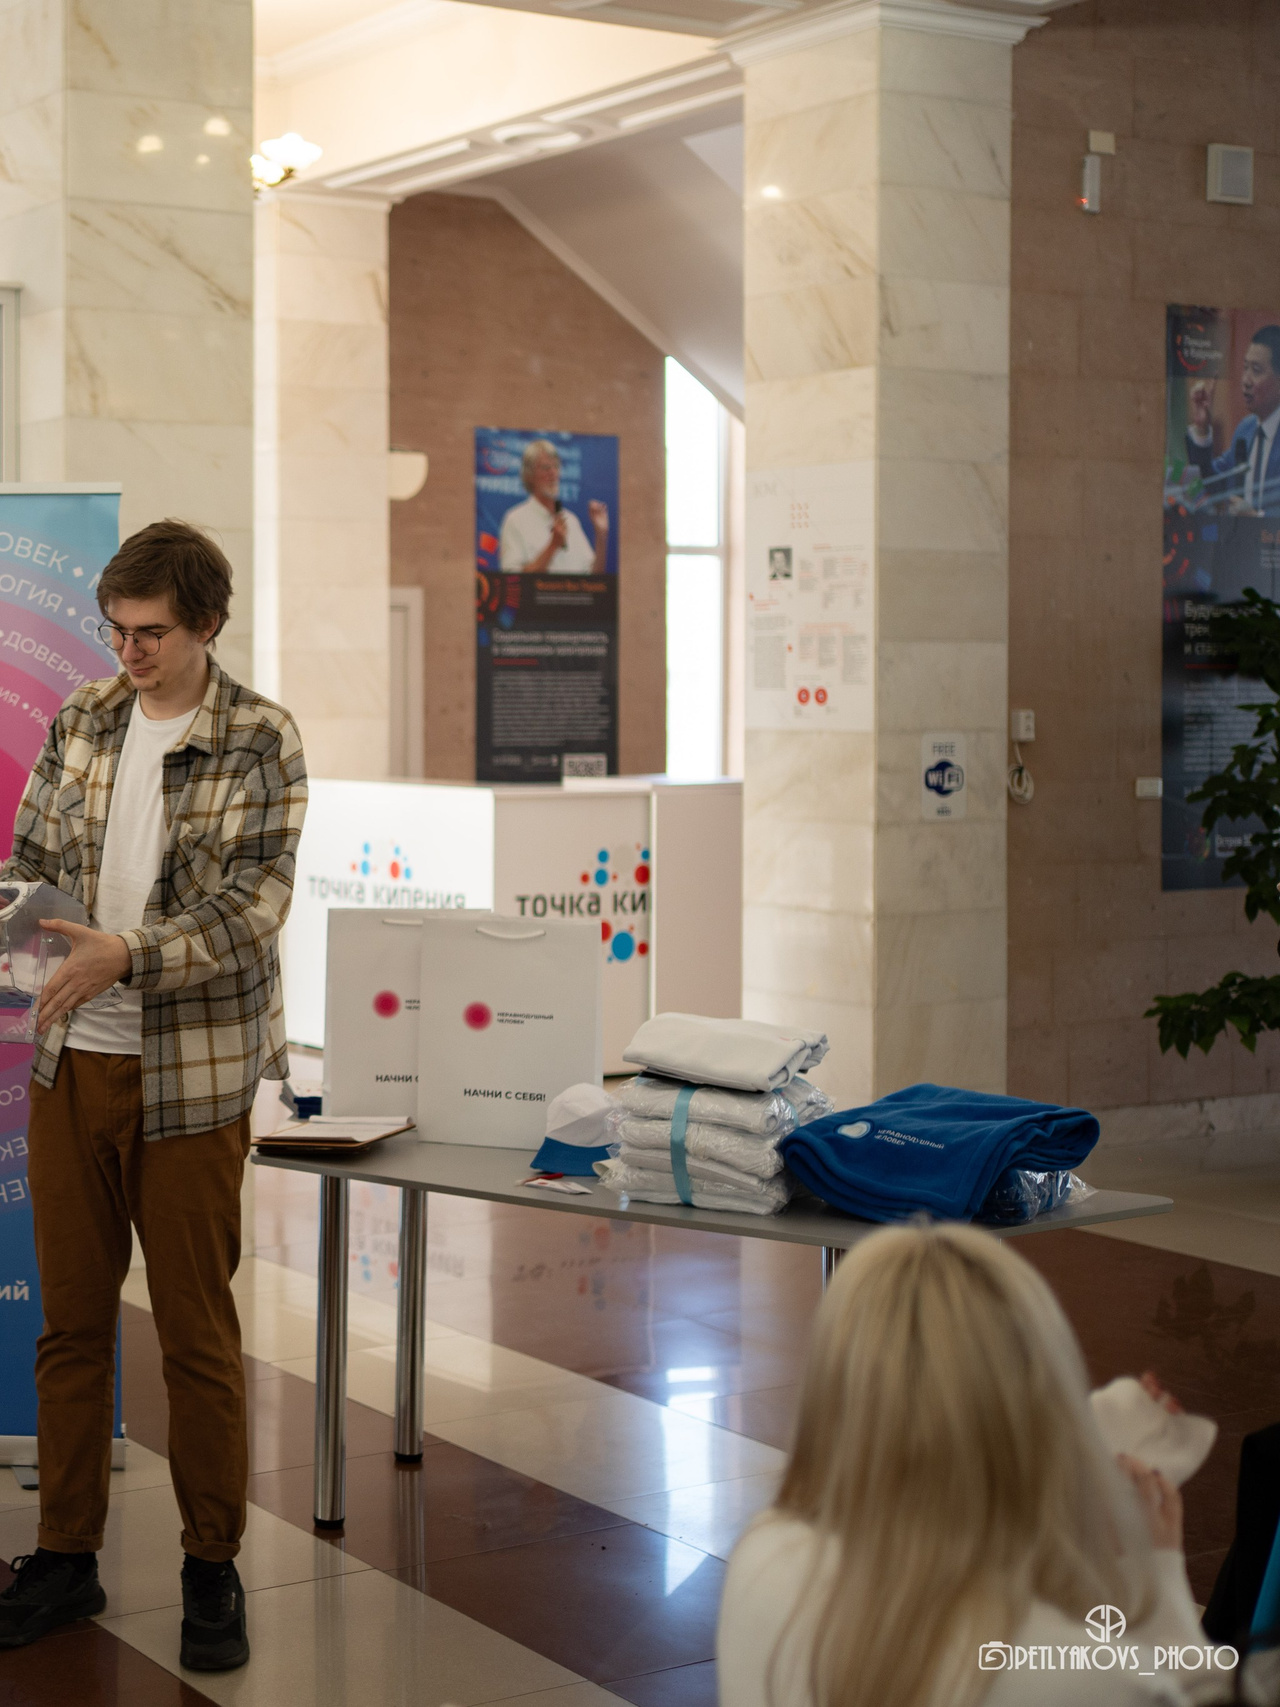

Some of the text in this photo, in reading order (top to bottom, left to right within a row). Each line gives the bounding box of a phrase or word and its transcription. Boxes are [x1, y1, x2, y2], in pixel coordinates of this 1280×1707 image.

[2, 630, 89, 688] ДОВЕРИ
[932, 741, 956, 757] FREE
[308, 875, 366, 904] точка
[516, 890, 648, 917] точка ки
[497, 1012, 554, 1020] НЕРАВНОДУШНЫЙ
[375, 1074, 412, 1083] НАЧНИ
[463, 1088, 546, 1103] НАЧНИ С СЕБЯ!
